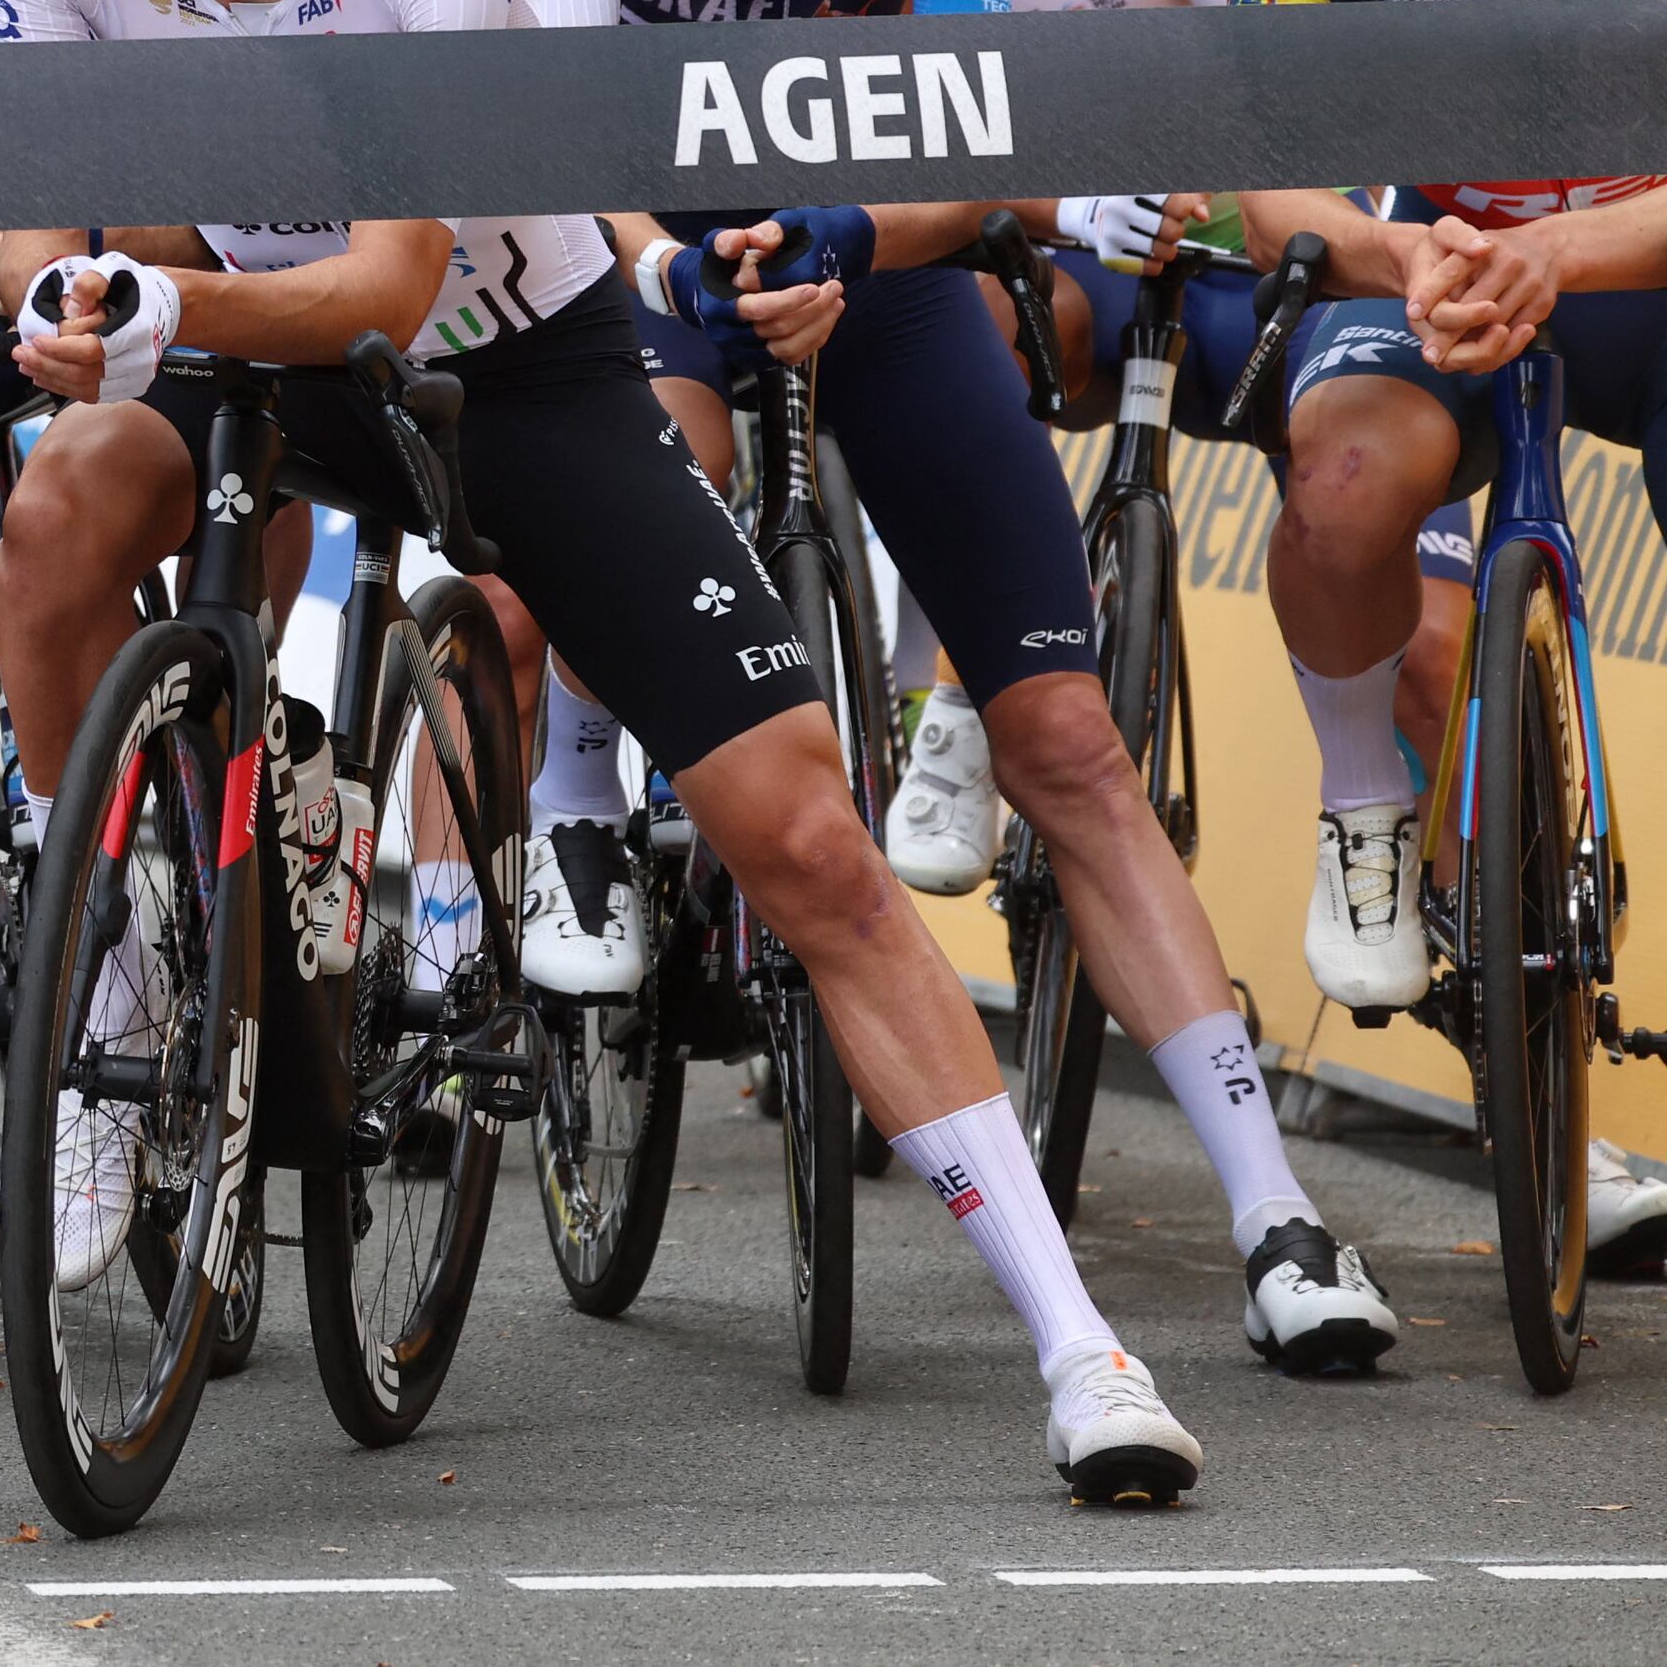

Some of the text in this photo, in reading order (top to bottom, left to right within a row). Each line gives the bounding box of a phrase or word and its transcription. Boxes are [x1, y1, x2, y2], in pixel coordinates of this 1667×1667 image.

[674, 50, 1014, 167] AGEN
[162, 365, 215, 377] wahoo
[1230, 321, 1281, 408] SRAM
[784, 367, 815, 502] ACTOR
[245, 744, 264, 837] Emirates
[266, 657, 320, 983] COLNAGO
